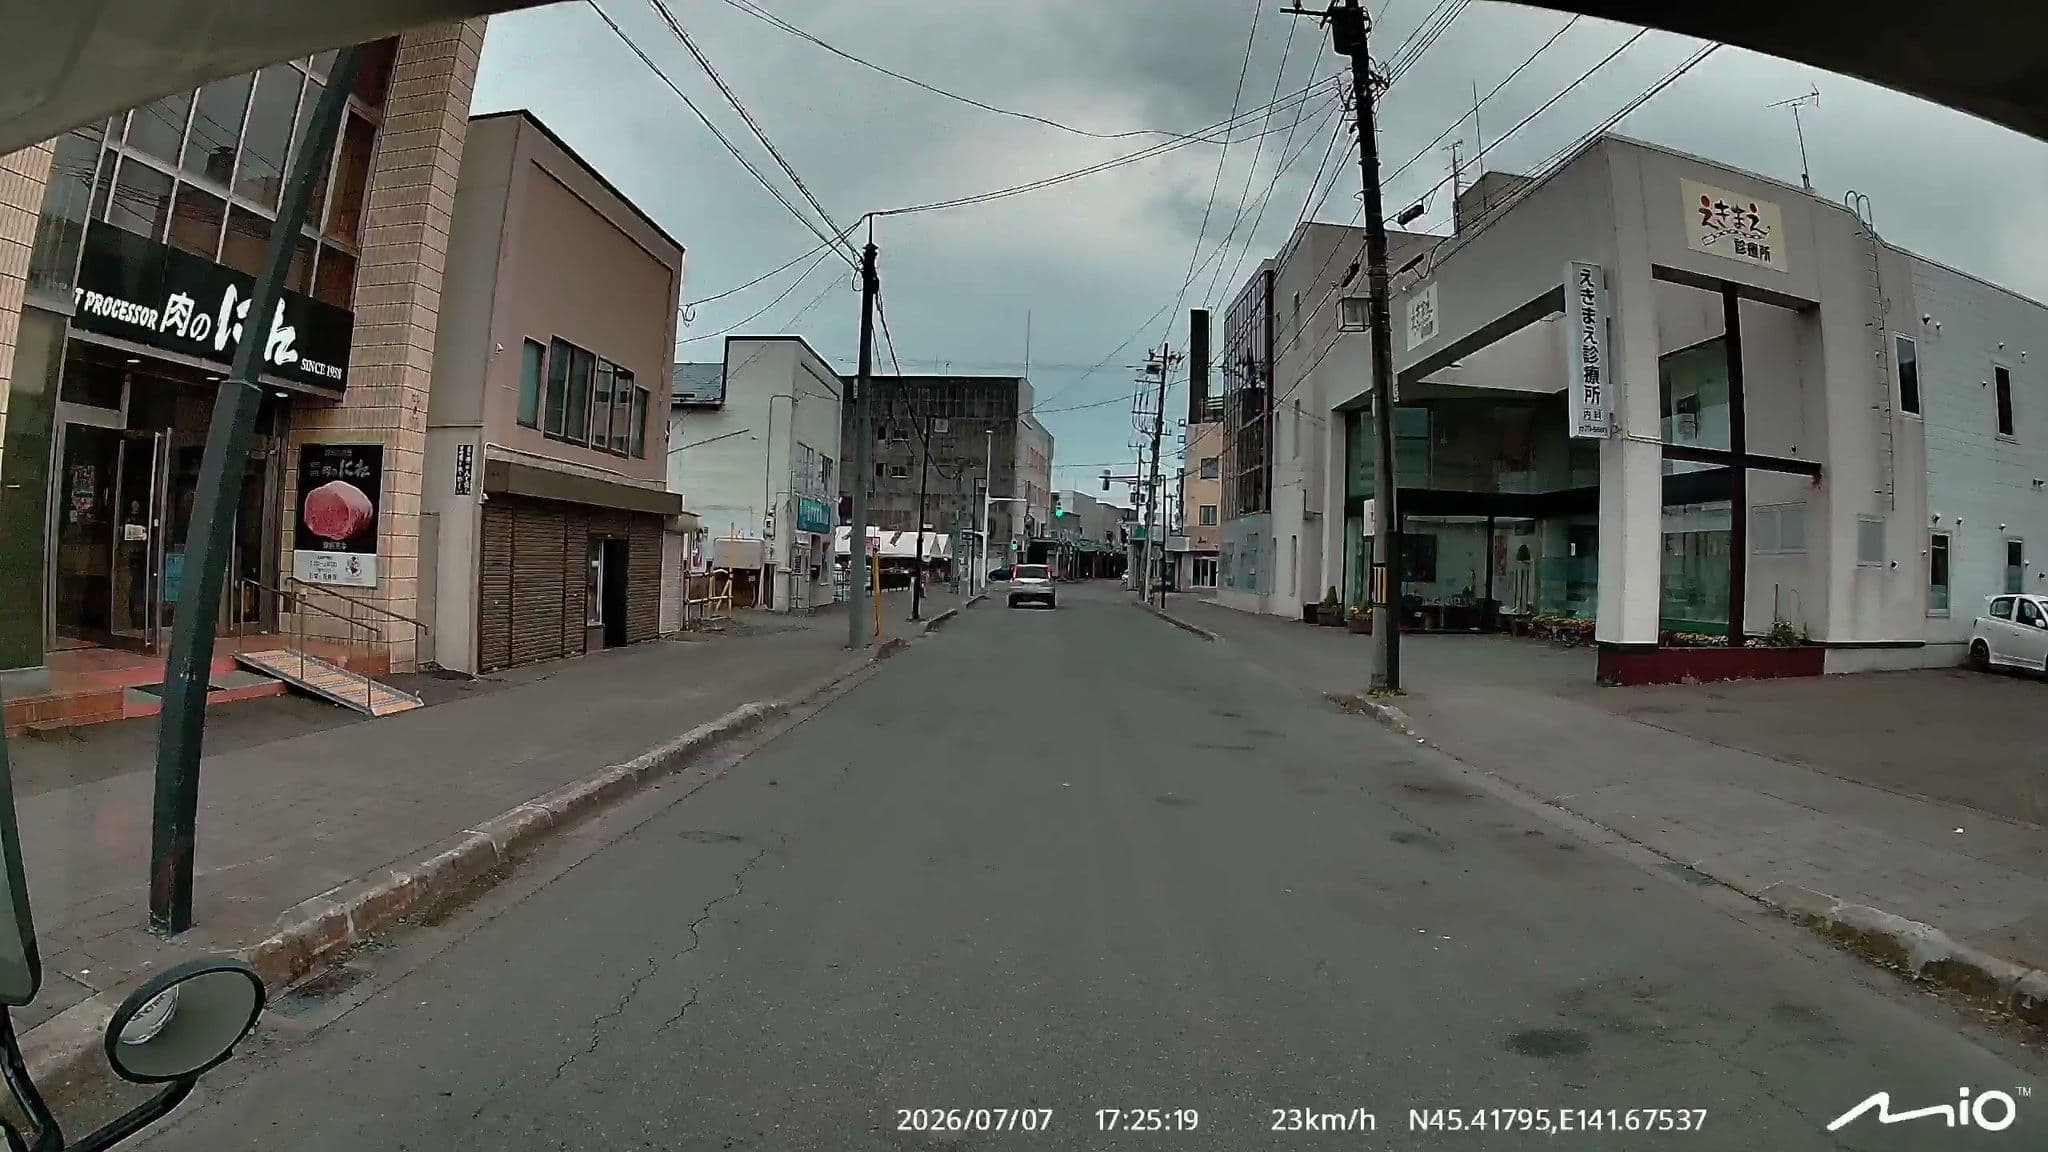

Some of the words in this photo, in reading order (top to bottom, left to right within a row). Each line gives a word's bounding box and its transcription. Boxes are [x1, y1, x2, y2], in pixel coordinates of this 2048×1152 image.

[1699, 195, 1768, 235] えきまえ
[84, 290, 158, 330] PROCESSOR
[1579, 268, 1601, 405] えきまえ診療所
[300, 357, 326, 375] SINCE
